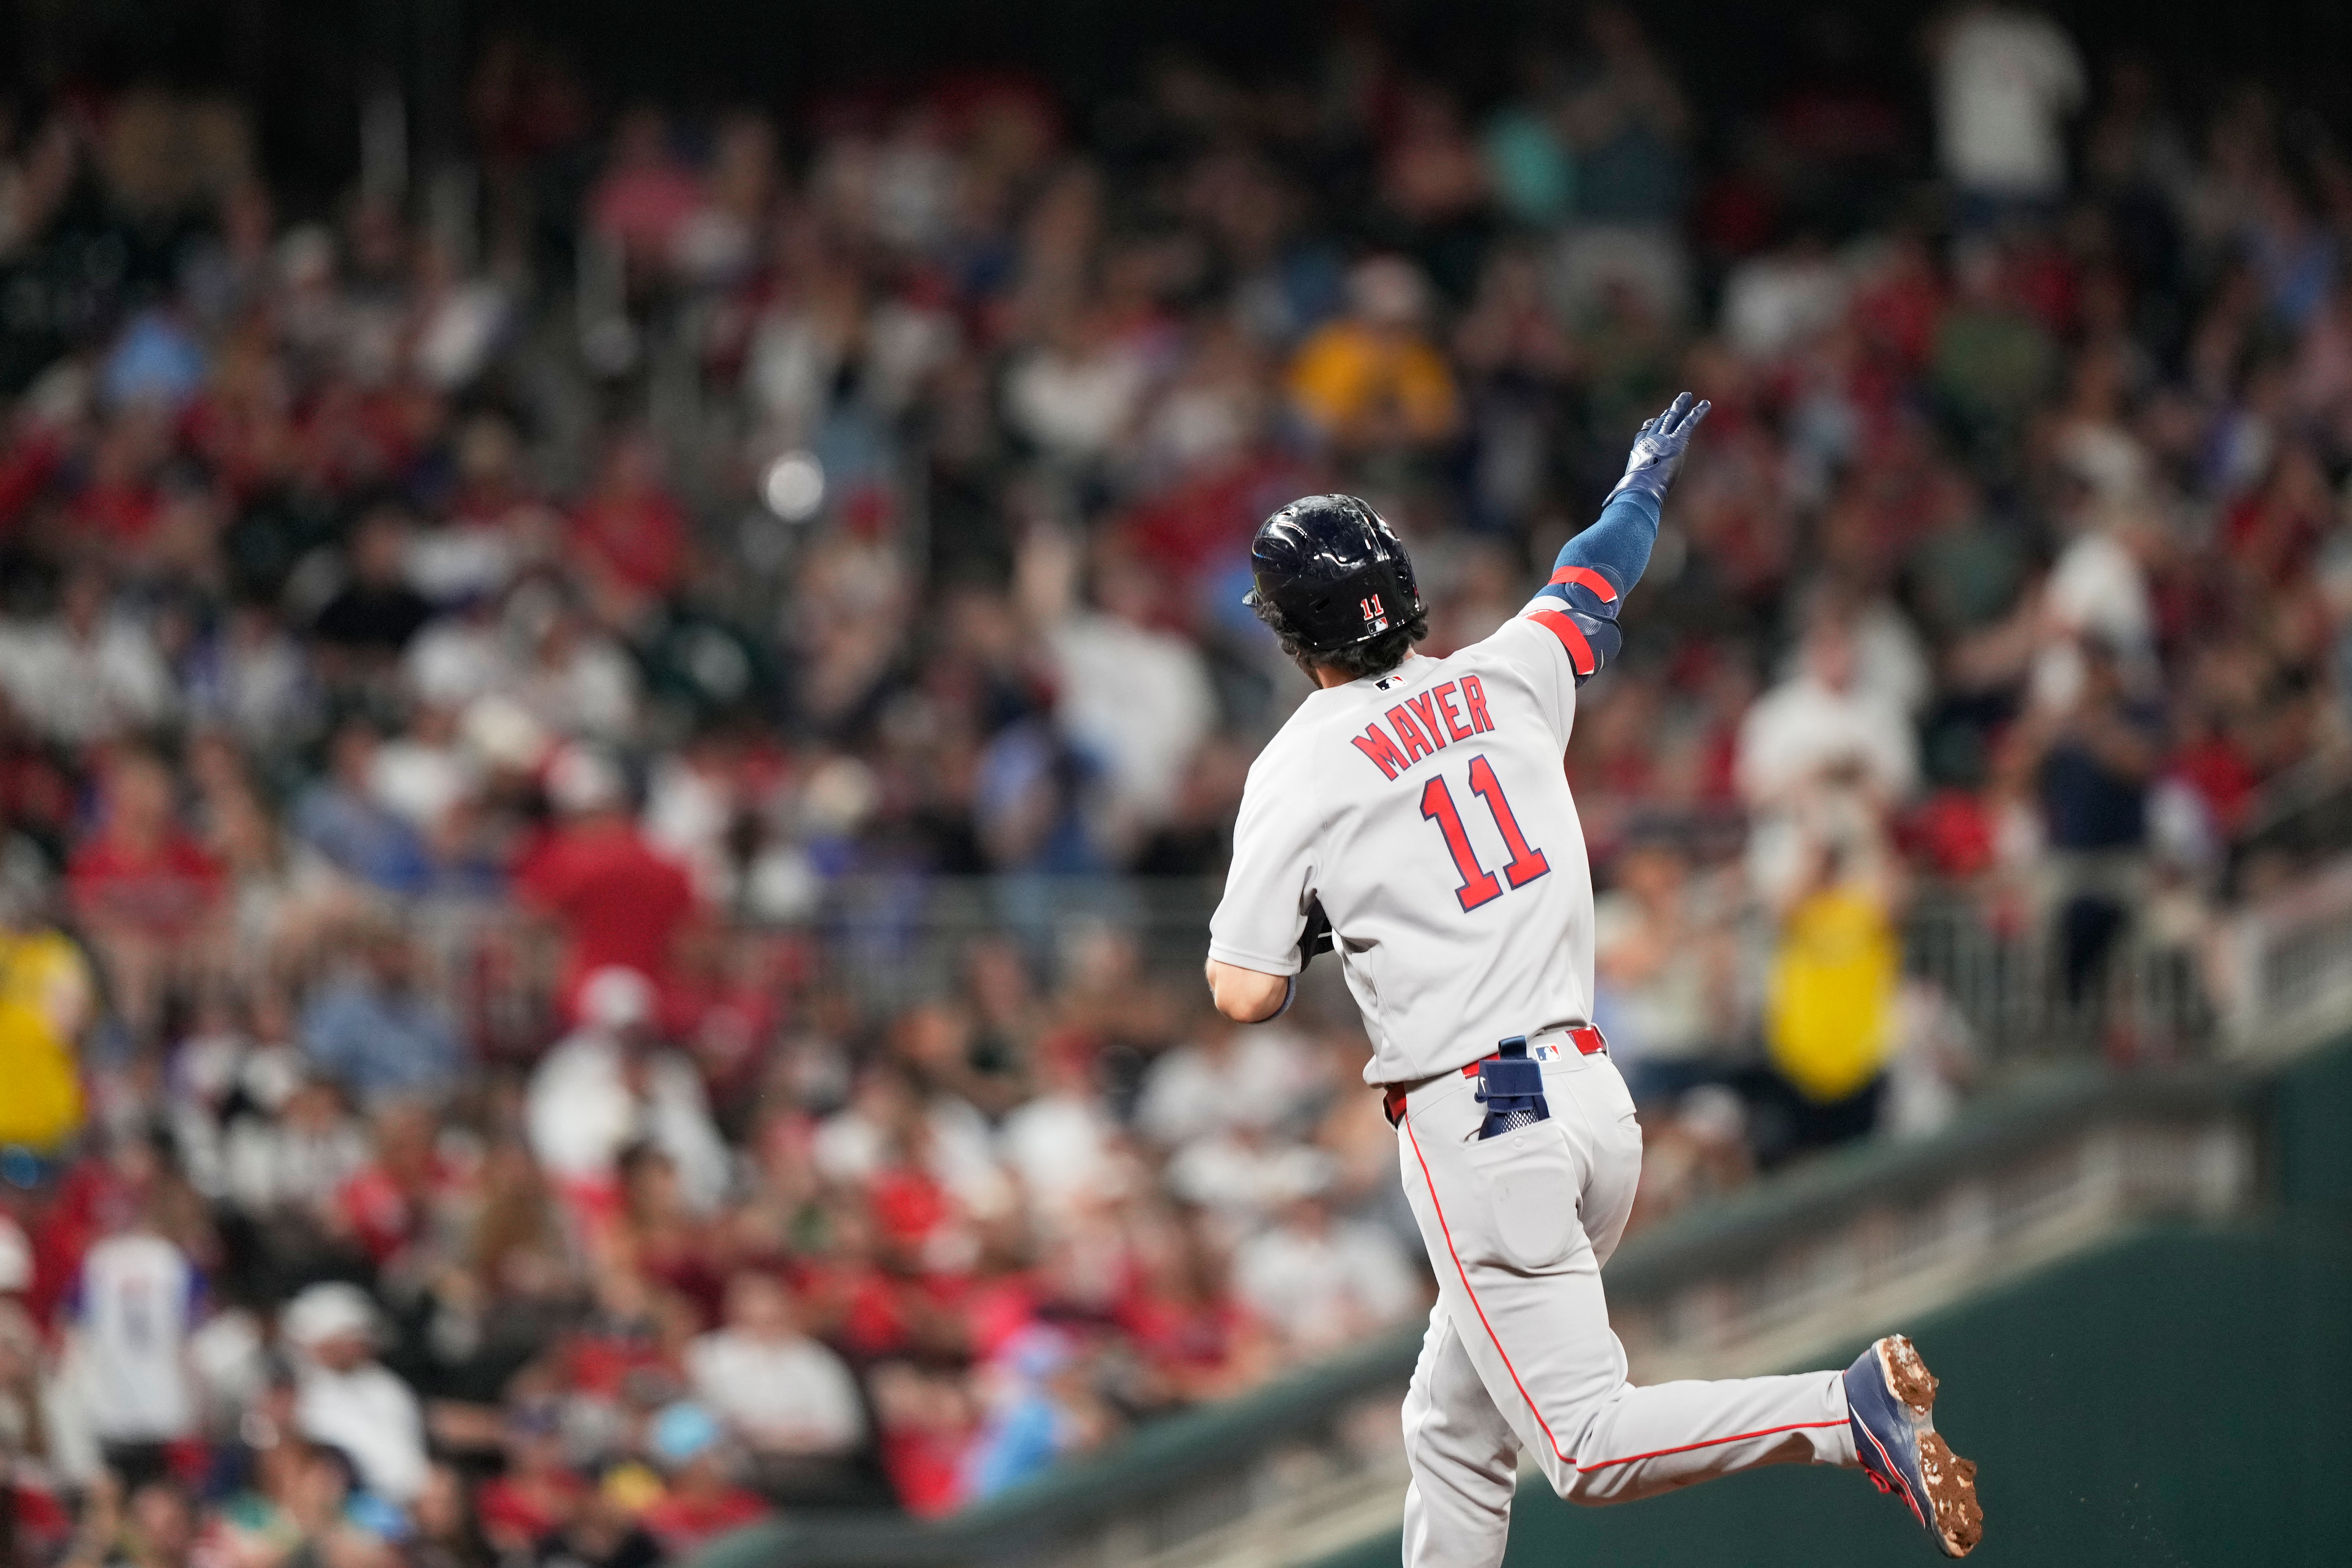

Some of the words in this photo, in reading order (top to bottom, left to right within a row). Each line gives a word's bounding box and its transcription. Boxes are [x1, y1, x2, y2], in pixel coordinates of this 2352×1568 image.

[1360, 593, 1384, 621] 11
[1351, 675, 1495, 781] MAYER
[1420, 754, 1551, 913] 11
